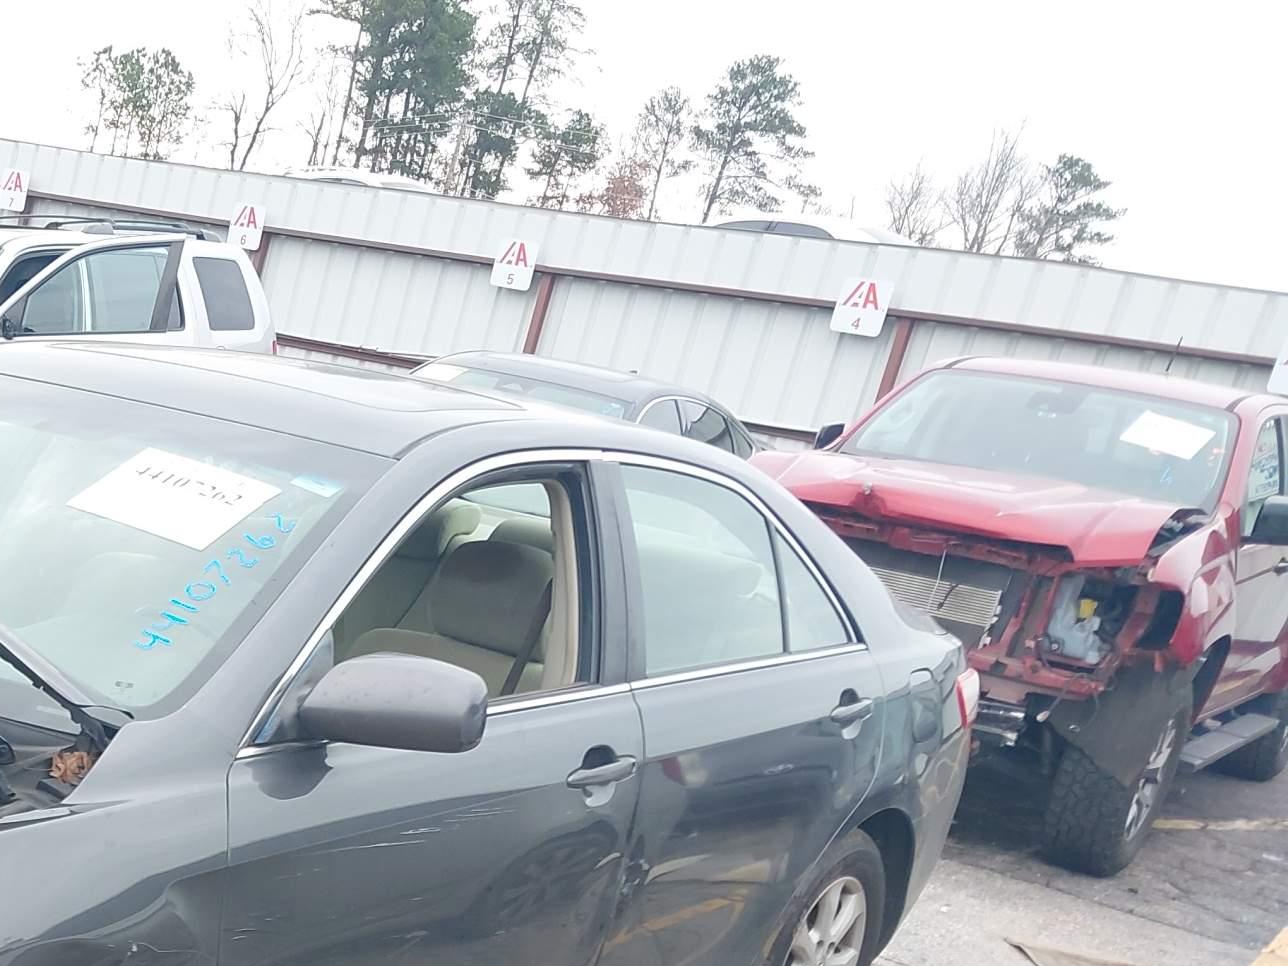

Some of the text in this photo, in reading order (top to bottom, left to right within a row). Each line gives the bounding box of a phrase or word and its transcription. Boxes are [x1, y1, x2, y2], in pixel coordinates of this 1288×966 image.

[9, 197, 15, 208] 7
[240, 234, 247, 246] 6
[506, 273, 515, 285] 5
[851, 317, 862, 330] 4
